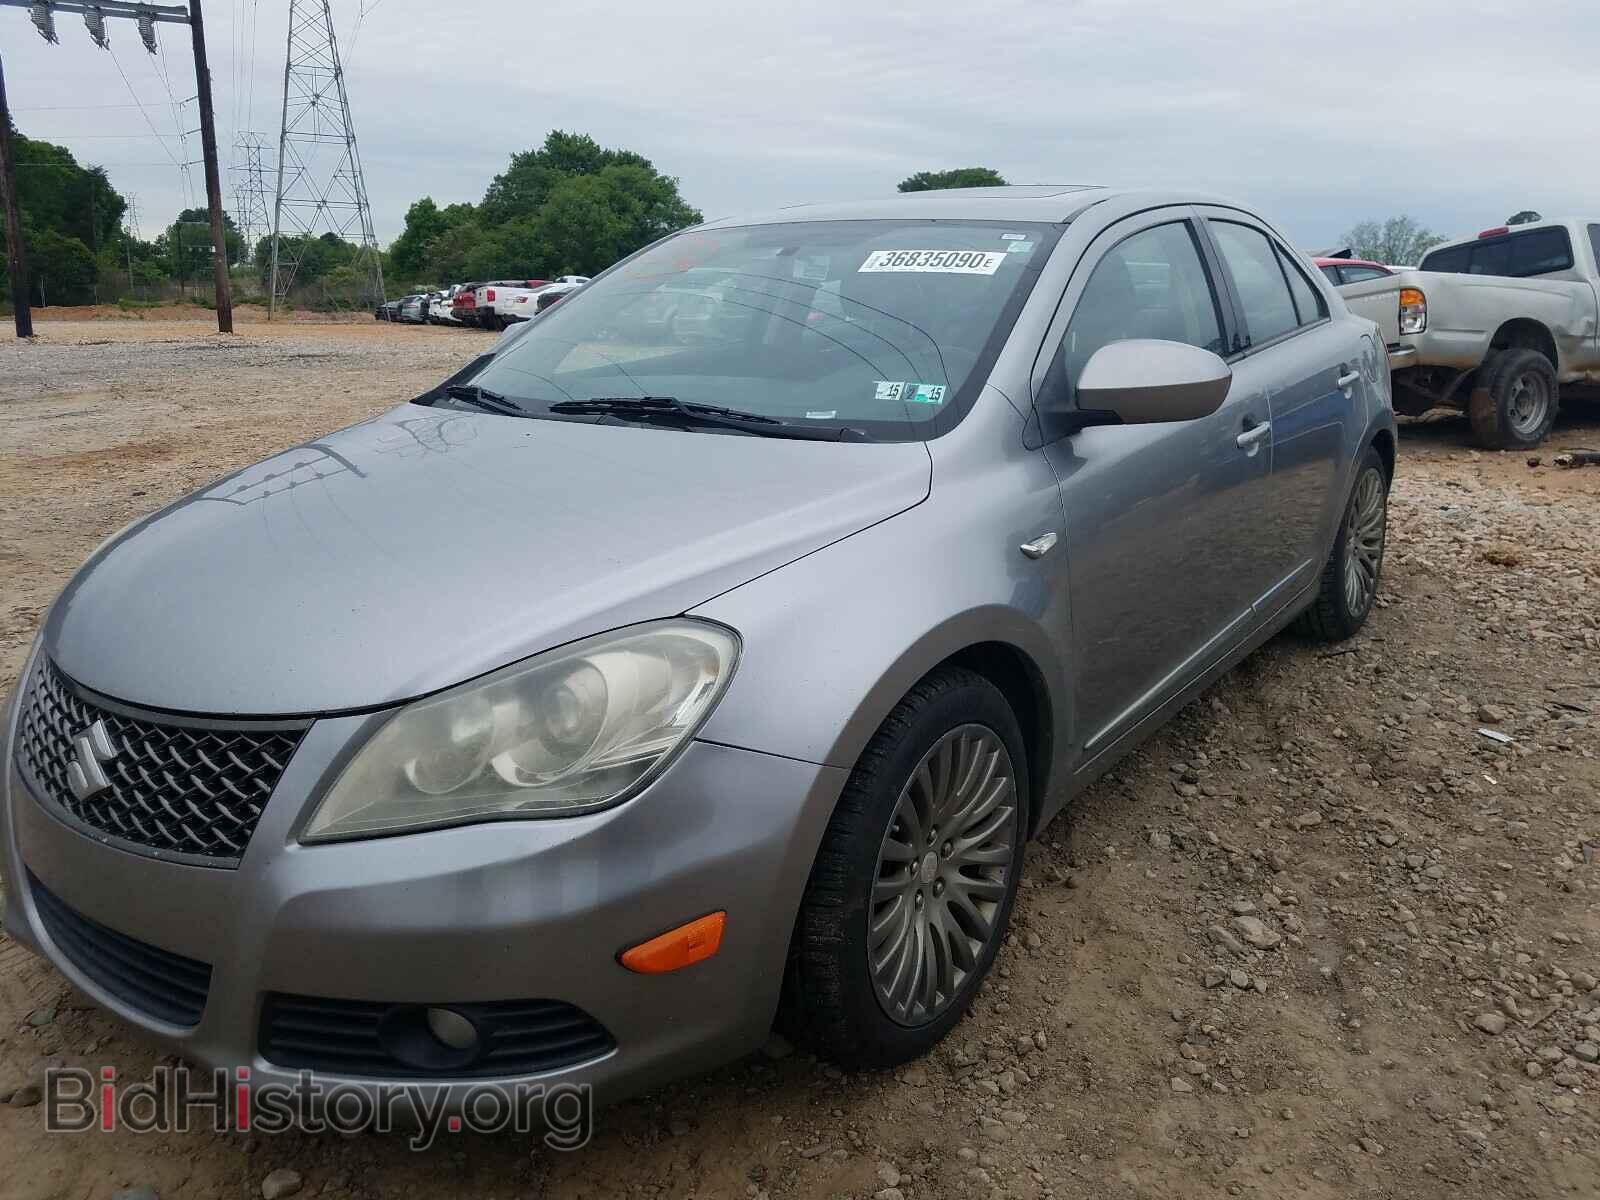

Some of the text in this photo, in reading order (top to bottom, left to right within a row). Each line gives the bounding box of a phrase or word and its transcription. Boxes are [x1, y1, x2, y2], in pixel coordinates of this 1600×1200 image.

[879, 252, 986, 269] 36835090
[887, 384, 901, 397] 15
[928, 387, 943, 400] 15
